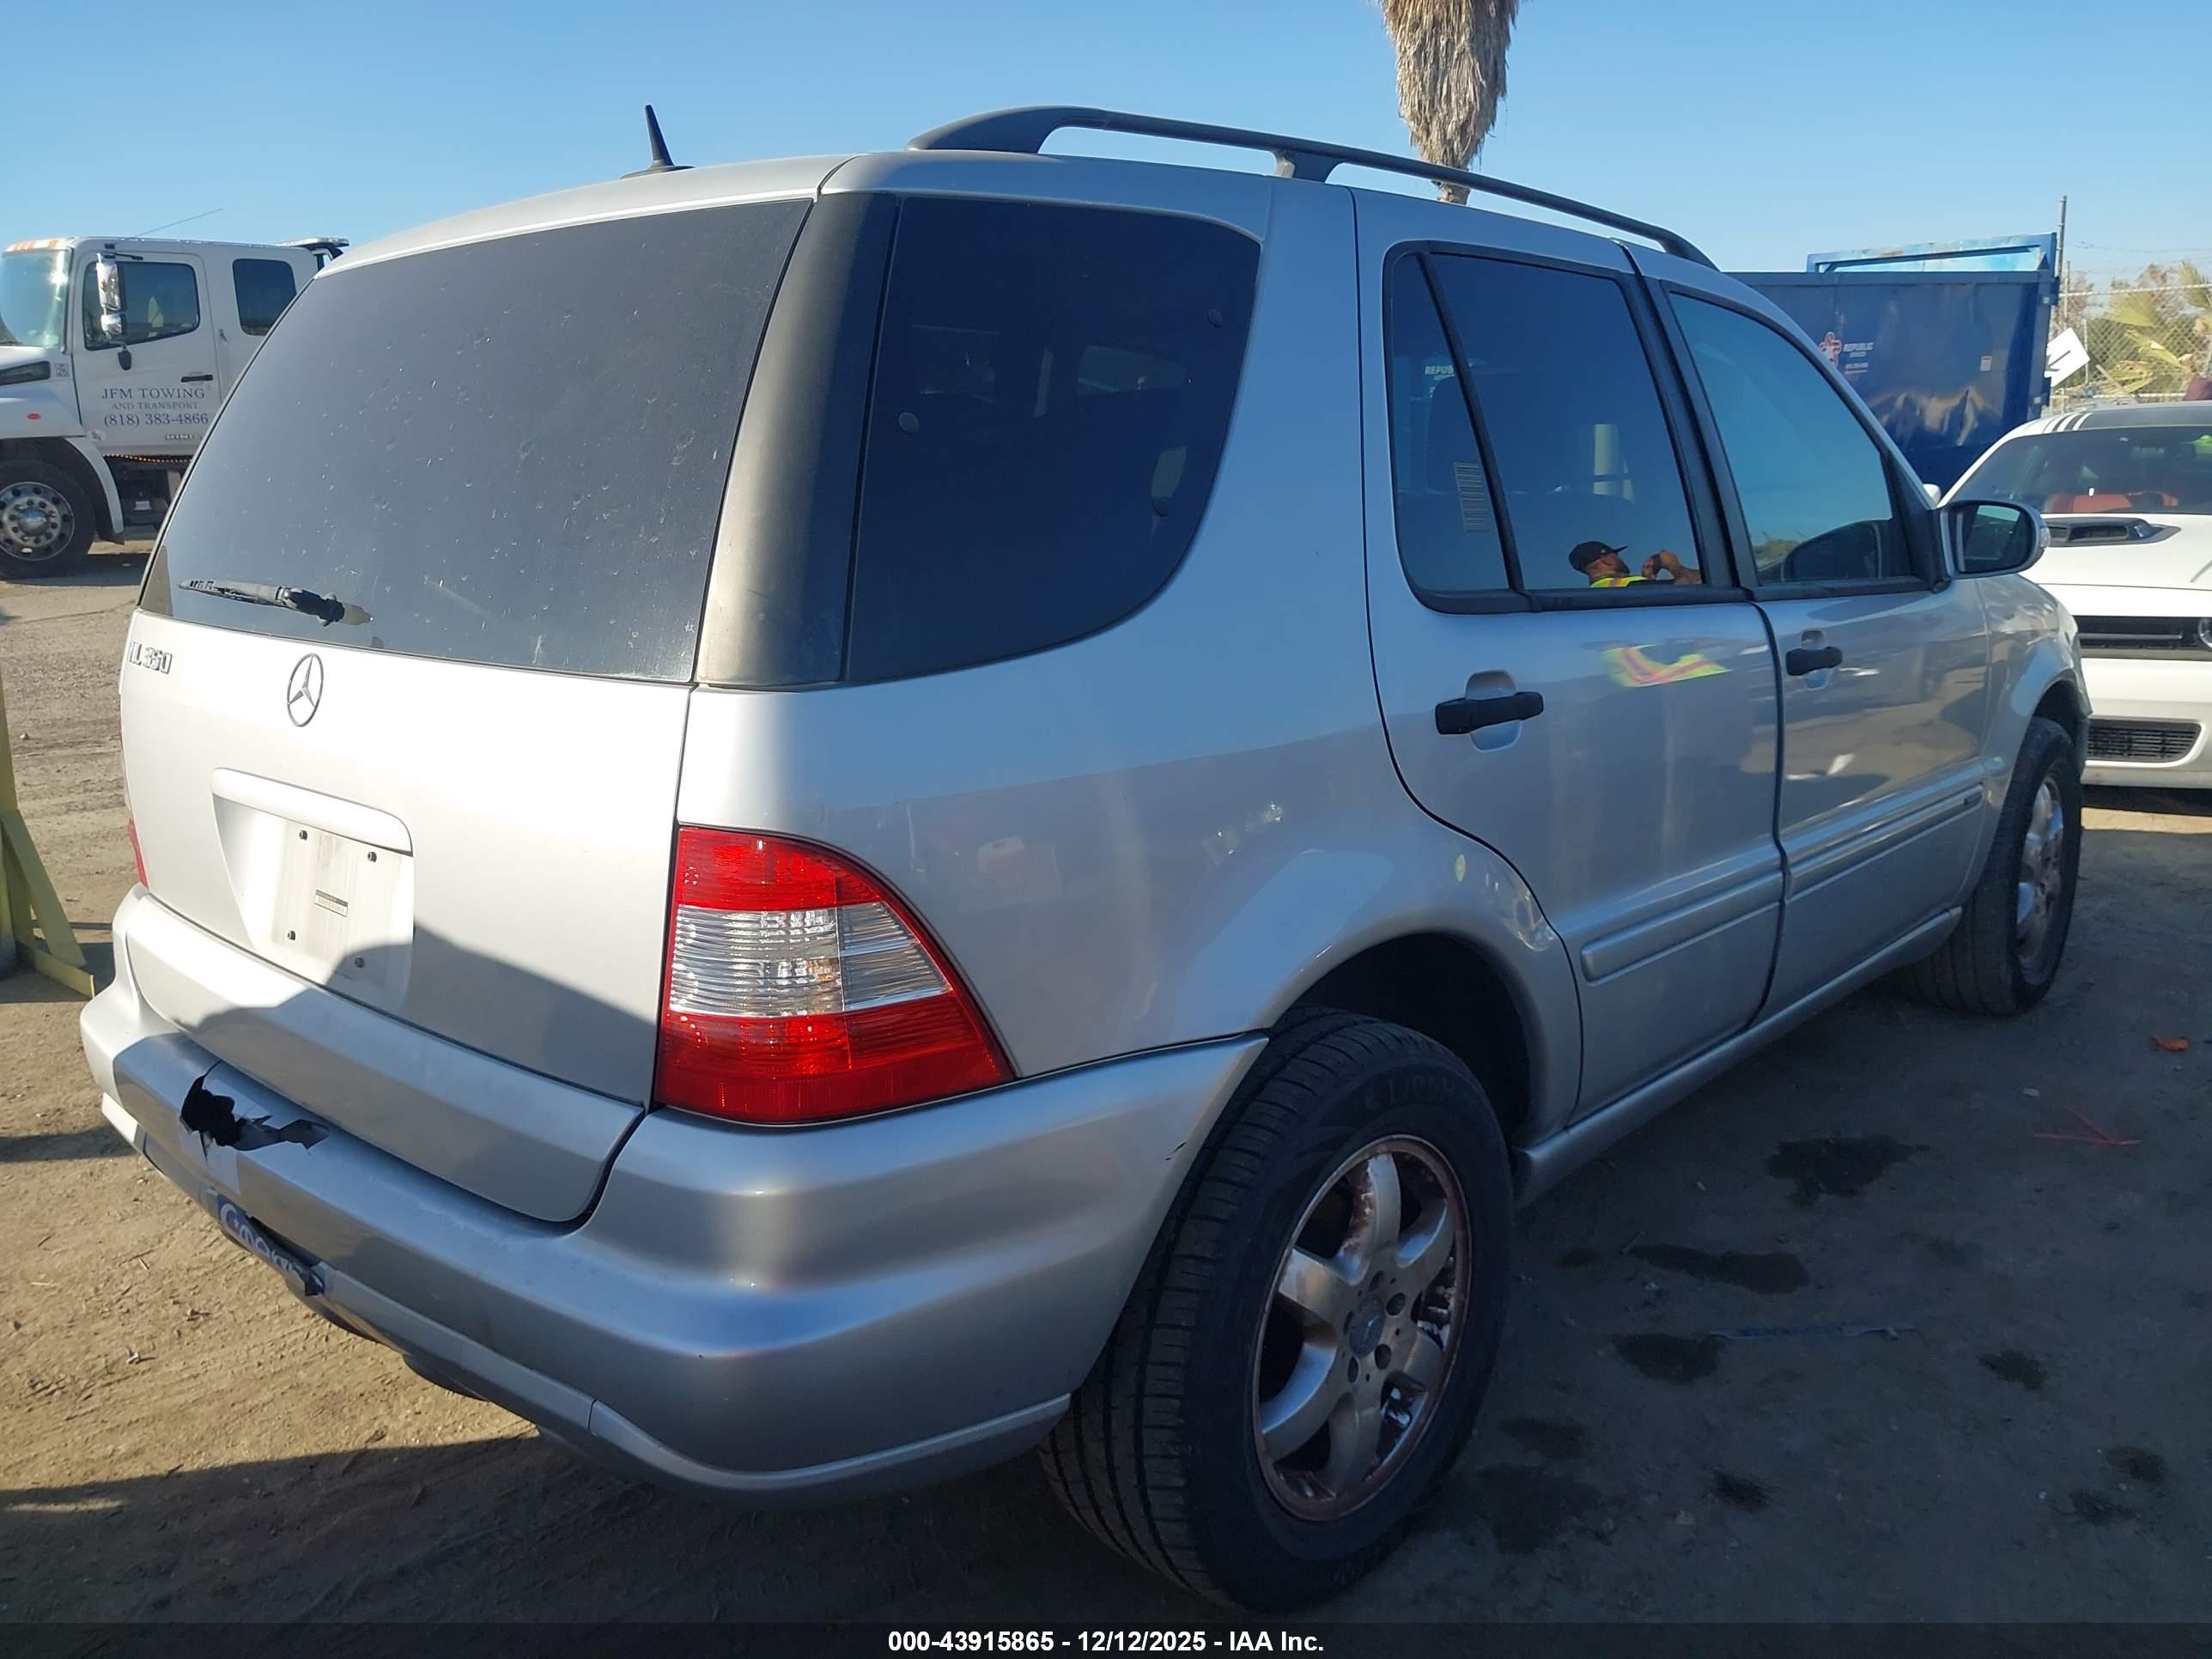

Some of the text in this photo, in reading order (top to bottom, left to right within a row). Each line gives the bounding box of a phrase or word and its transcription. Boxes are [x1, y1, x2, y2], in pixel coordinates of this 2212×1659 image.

[101, 387, 205, 399] JFM TOWING
[111, 401, 199, 410] AND TRANSPORT
[104, 412, 209, 427] (818) 383-4866
